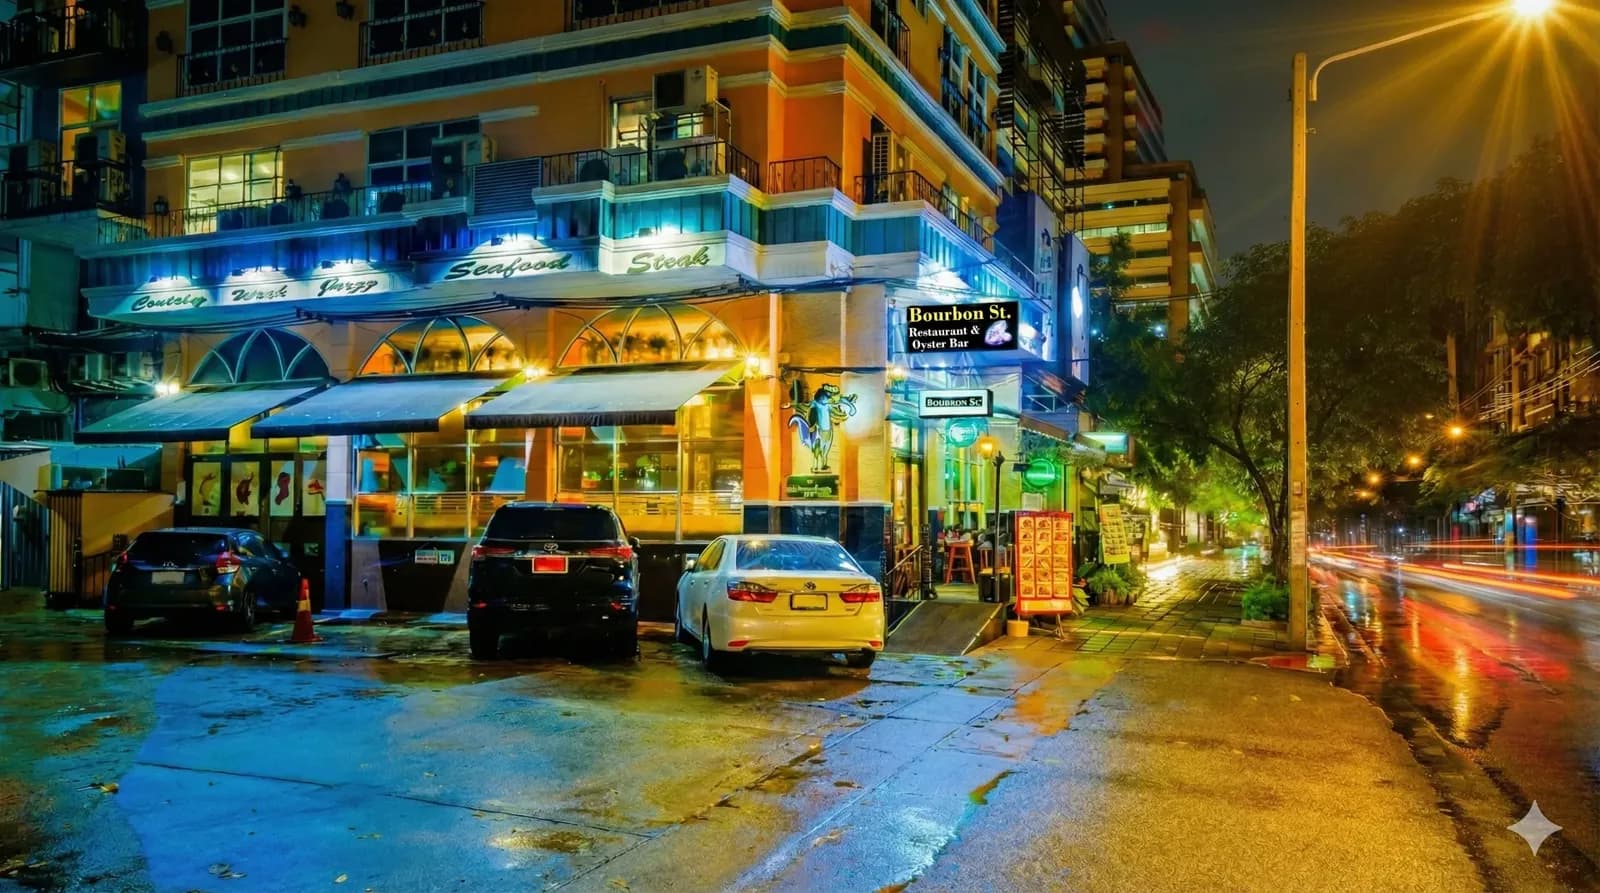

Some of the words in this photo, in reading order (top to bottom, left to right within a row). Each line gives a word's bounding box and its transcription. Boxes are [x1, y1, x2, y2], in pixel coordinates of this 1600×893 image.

[444, 253, 572, 279] Seafood
[627, 246, 710, 274] Steak
[909, 305, 984, 322] Bourbon
[989, 304, 1011, 320] St.
[909, 327, 967, 338] Restaurant
[970, 325, 981, 335] &
[912, 339, 946, 352] Oyster
[949, 337, 969, 348] Bar
